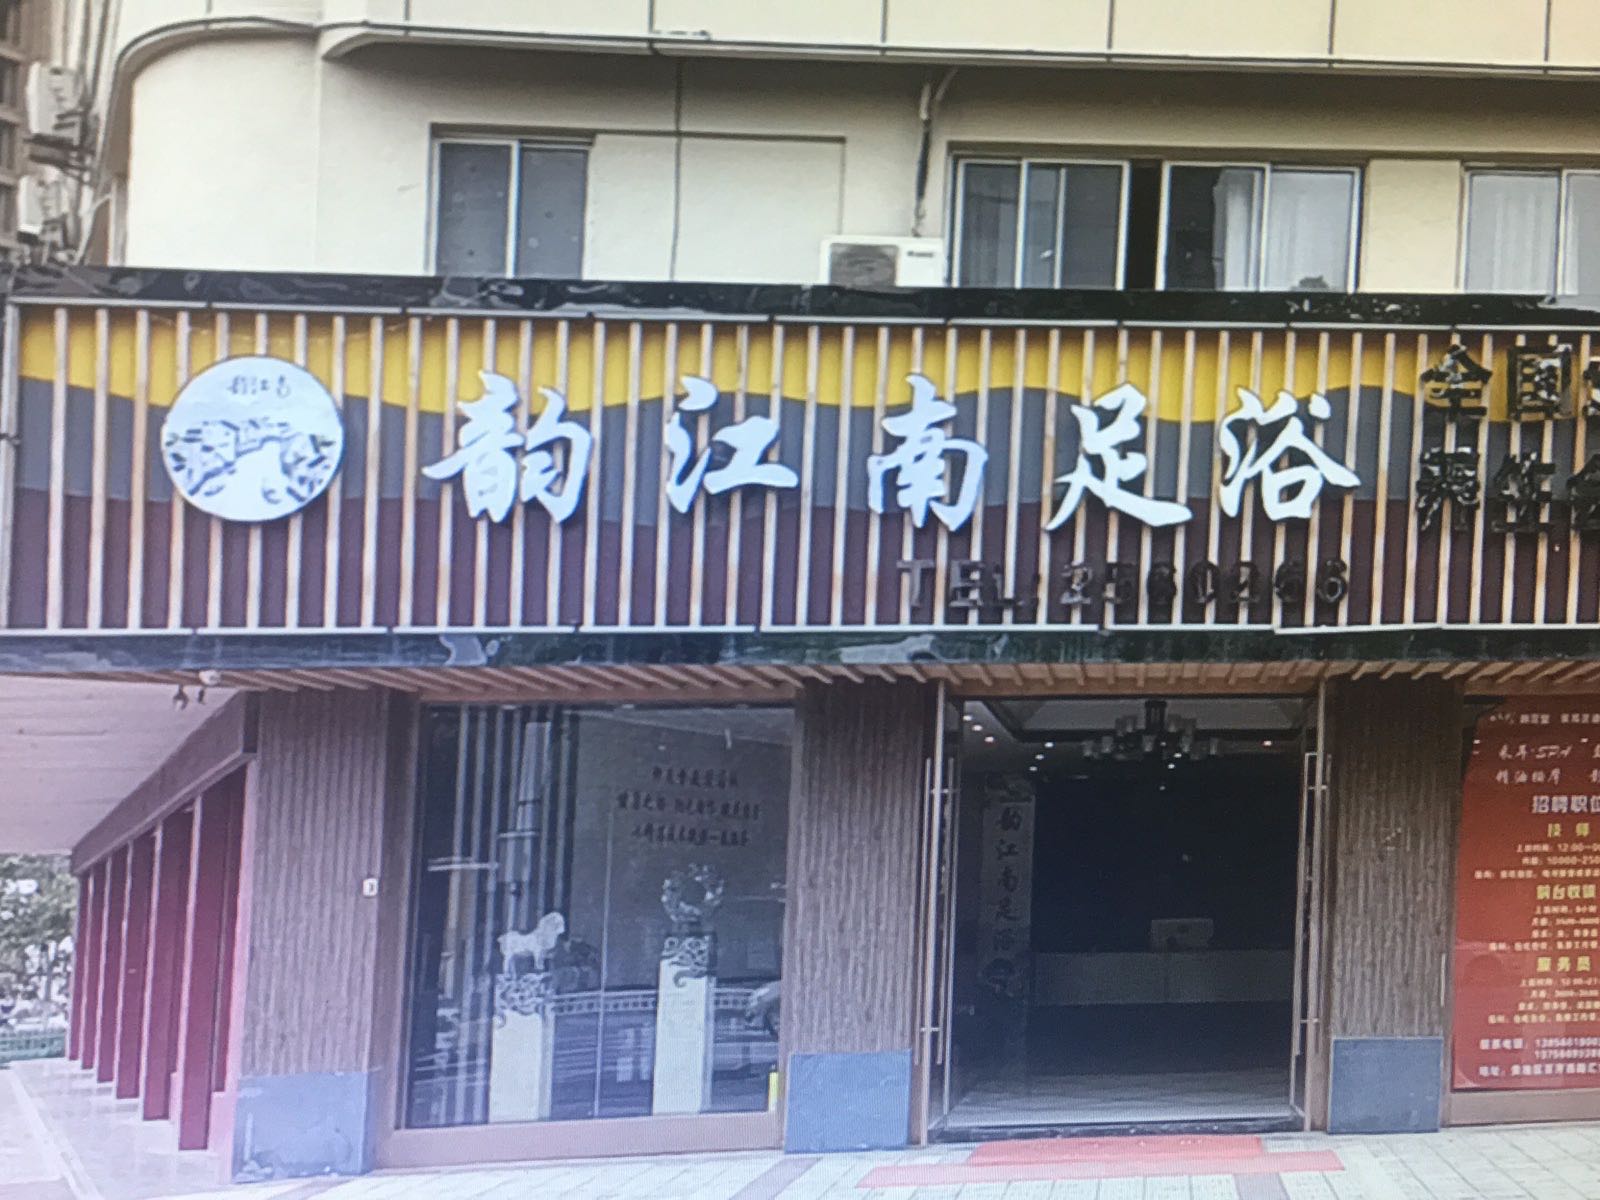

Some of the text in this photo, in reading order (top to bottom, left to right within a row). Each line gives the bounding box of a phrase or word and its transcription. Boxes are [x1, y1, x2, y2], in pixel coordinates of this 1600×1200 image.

[422, 371, 1360, 532] 韵江南足浴
